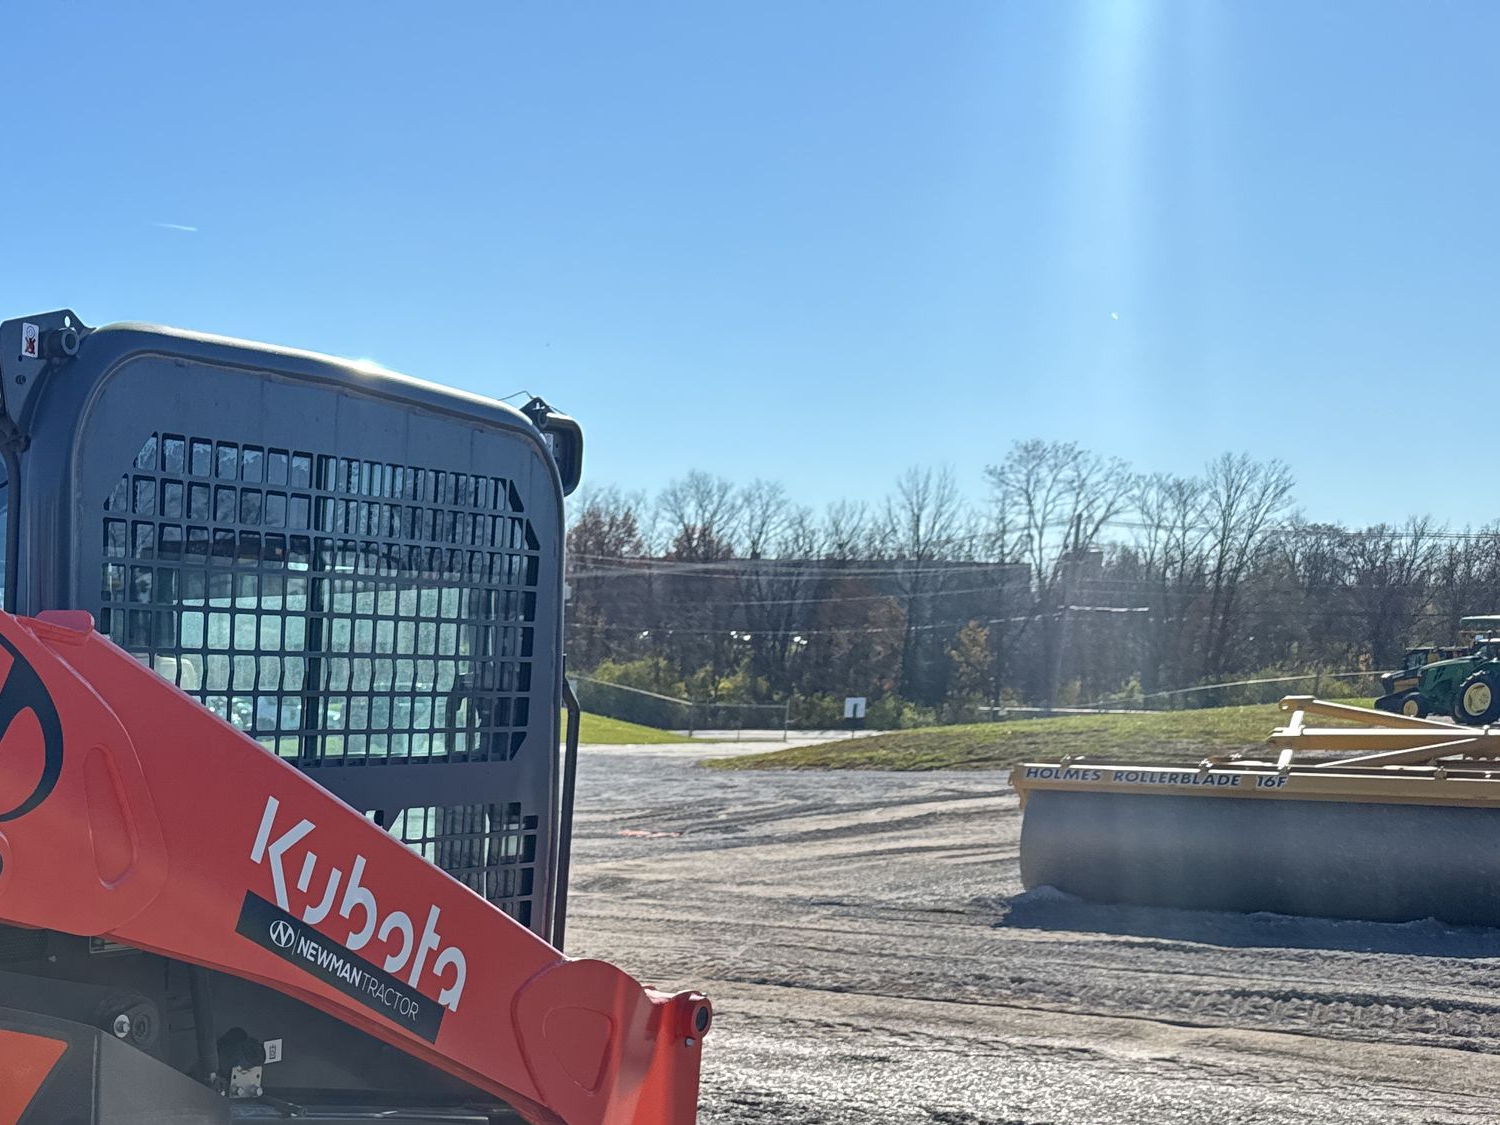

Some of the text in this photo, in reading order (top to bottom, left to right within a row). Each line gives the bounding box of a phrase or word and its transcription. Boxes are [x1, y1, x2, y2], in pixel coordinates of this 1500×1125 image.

[1025, 768, 1288, 788] HOLMES ROLLERBLADE 16F
[250, 795, 467, 1013] Kubota
